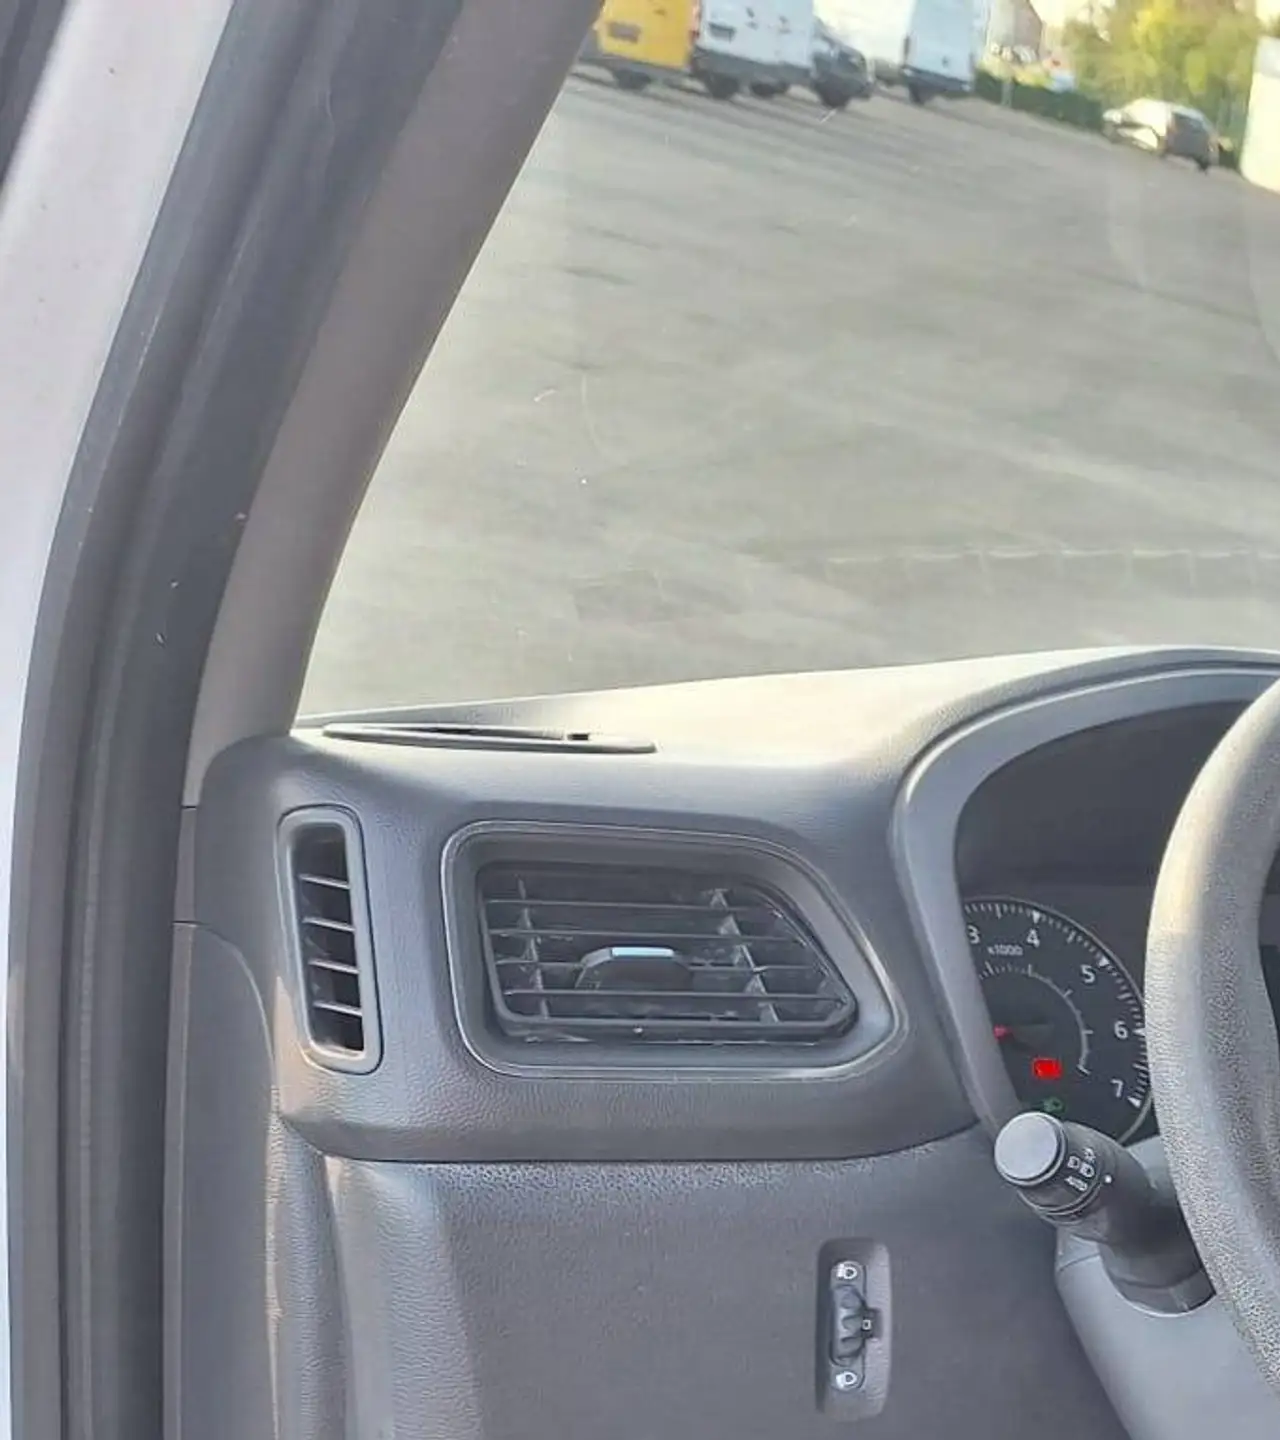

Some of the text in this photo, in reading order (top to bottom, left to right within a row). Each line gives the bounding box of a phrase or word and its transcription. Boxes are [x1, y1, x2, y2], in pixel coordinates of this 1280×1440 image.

[967, 925, 980, 944] 3
[1026, 929, 1040, 947] 4
[1080, 964, 1096, 983] 5
[1114, 1021, 1128, 1040] 6
[1110, 1079, 1124, 1098] 7
